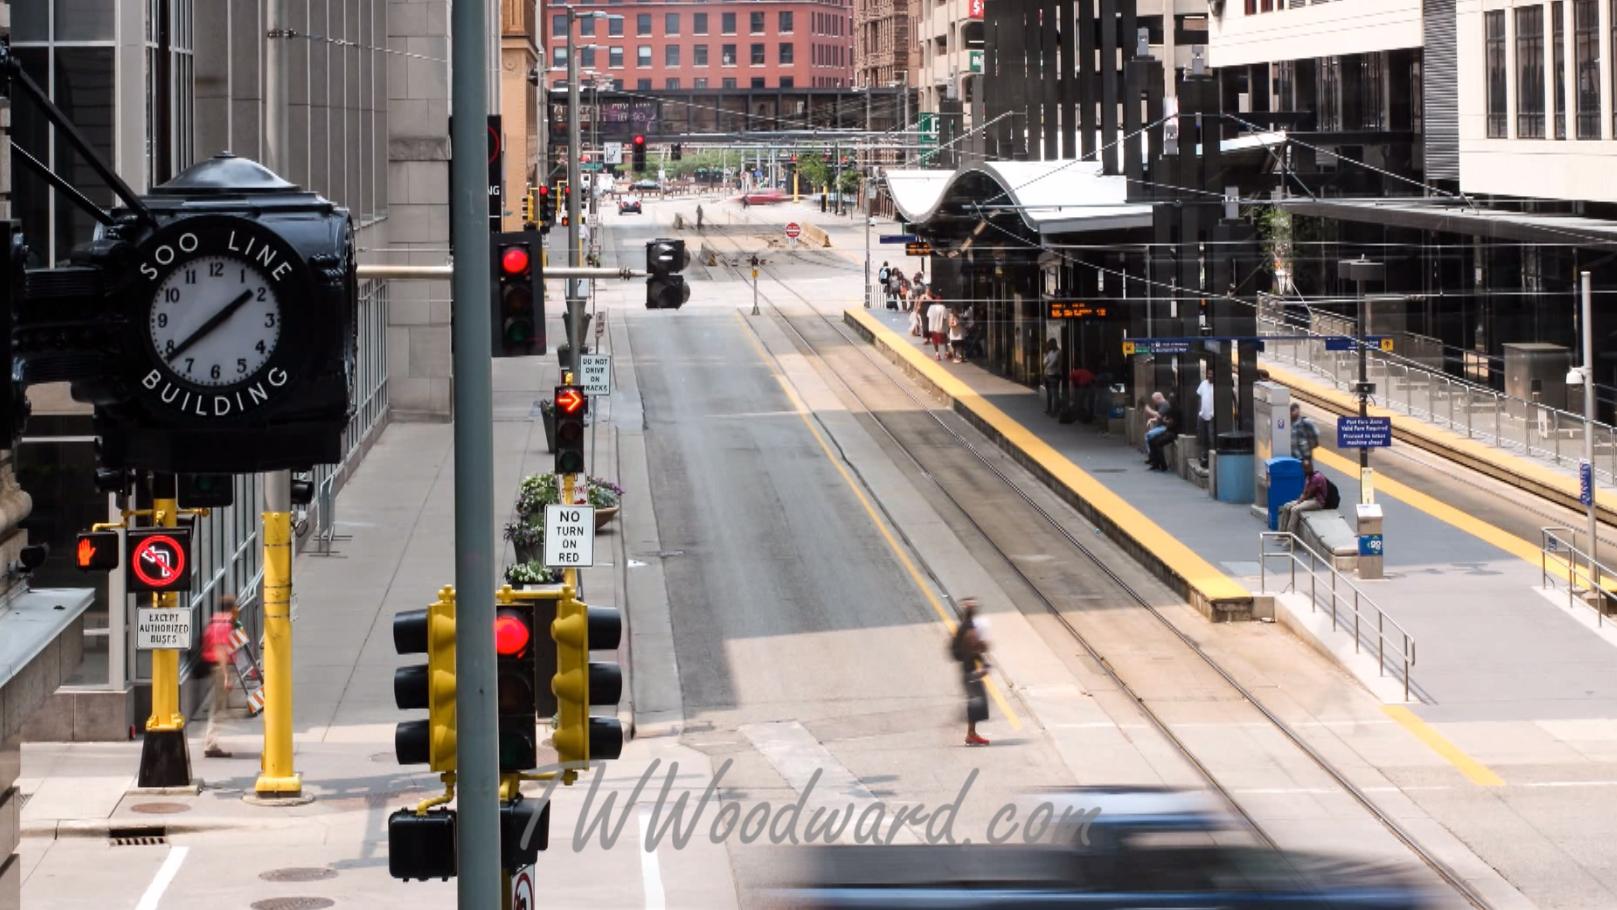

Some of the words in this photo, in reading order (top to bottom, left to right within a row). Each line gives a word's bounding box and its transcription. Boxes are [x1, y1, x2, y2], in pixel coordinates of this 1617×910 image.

[140, 232, 199, 280] SOO
[228, 230, 293, 281] LINE
[185, 269, 196, 284] 11
[209, 262, 224, 277] 12
[240, 269, 245, 284] 1
[165, 287, 180, 303] 10
[257, 287, 267, 302] 2
[158, 313, 168, 328] 9
[265, 313, 275, 328] 3
[165, 339, 175, 354] 8
[255, 340, 266, 354] 4
[185, 358, 195, 373] 7
[211, 364, 221, 380] 6
[236, 358, 247, 373] 5
[142, 367, 288, 416] BUILDING
[560, 511, 580, 522] NO
[556, 526, 584, 536] TURN
[562, 540, 577, 548] ON
[559, 553, 579, 562] RED
[149, 613, 179, 622] EXCEPT
[139, 624, 189, 633] AUTHORIZED
[150, 635, 177, 644] BUSES
